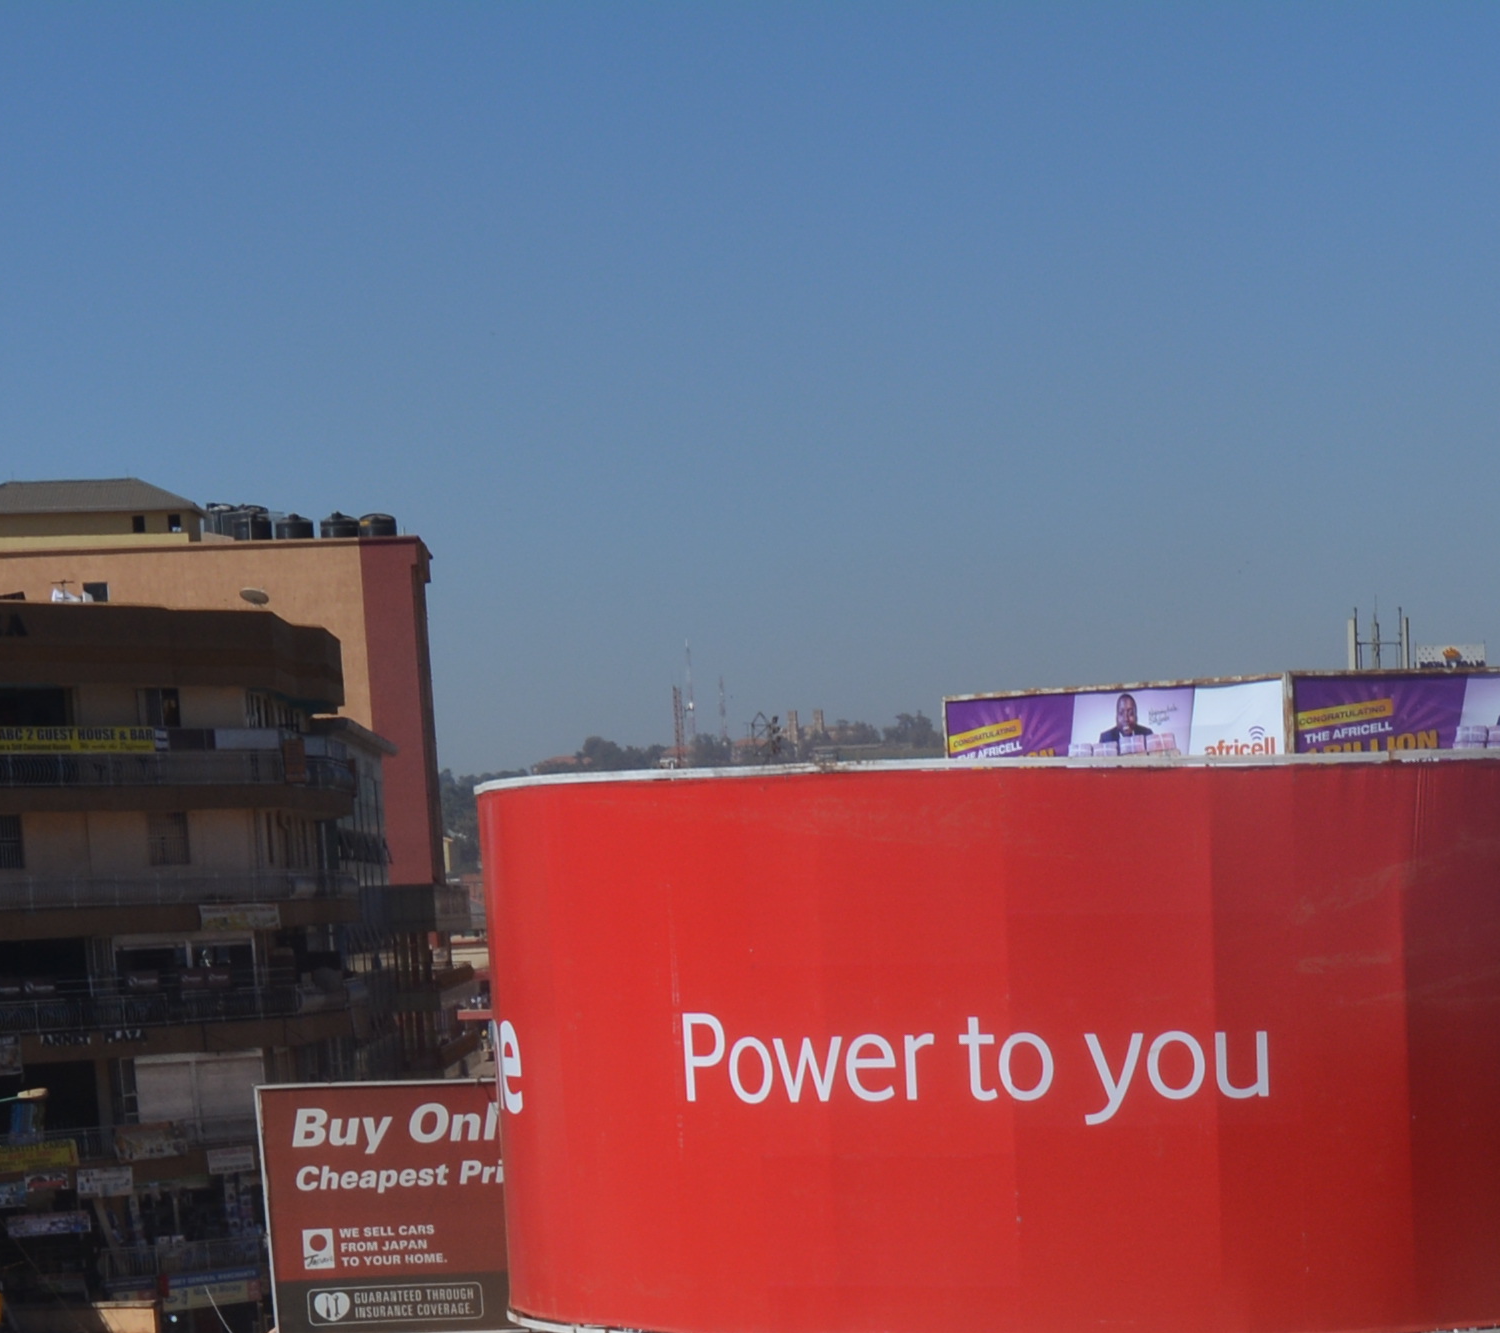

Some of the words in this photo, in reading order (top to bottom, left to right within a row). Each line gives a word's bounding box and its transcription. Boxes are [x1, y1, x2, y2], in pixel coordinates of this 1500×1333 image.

[1304, 732, 1330, 745] THE
[1332, 721, 1394, 742] AFRICELL
[681, 1011, 935, 1104] Power
[958, 1015, 1055, 1103] to
[1084, 1028, 1270, 1126] you
[292, 1107, 394, 1155] Buy
[295, 1163, 450, 1194] Cheapest
[339, 1227, 361, 1240] WE
[363, 1226, 395, 1238] SELL
[398, 1224, 436, 1236] CARS
[340, 1241, 379, 1253] FROM
[381, 1239, 428, 1252] JAPAN
[341, 1256, 360, 1267] TO
[364, 1254, 401, 1266] YOUR
[404, 1252, 449, 1265] HOME.
[353, 1289, 423, 1305] GUARANTEED
[425, 1287, 474, 1302] THROUGH
[354, 1304, 414, 1319] INSURANCE
[416, 1301, 475, 1317] COVERAGE.
